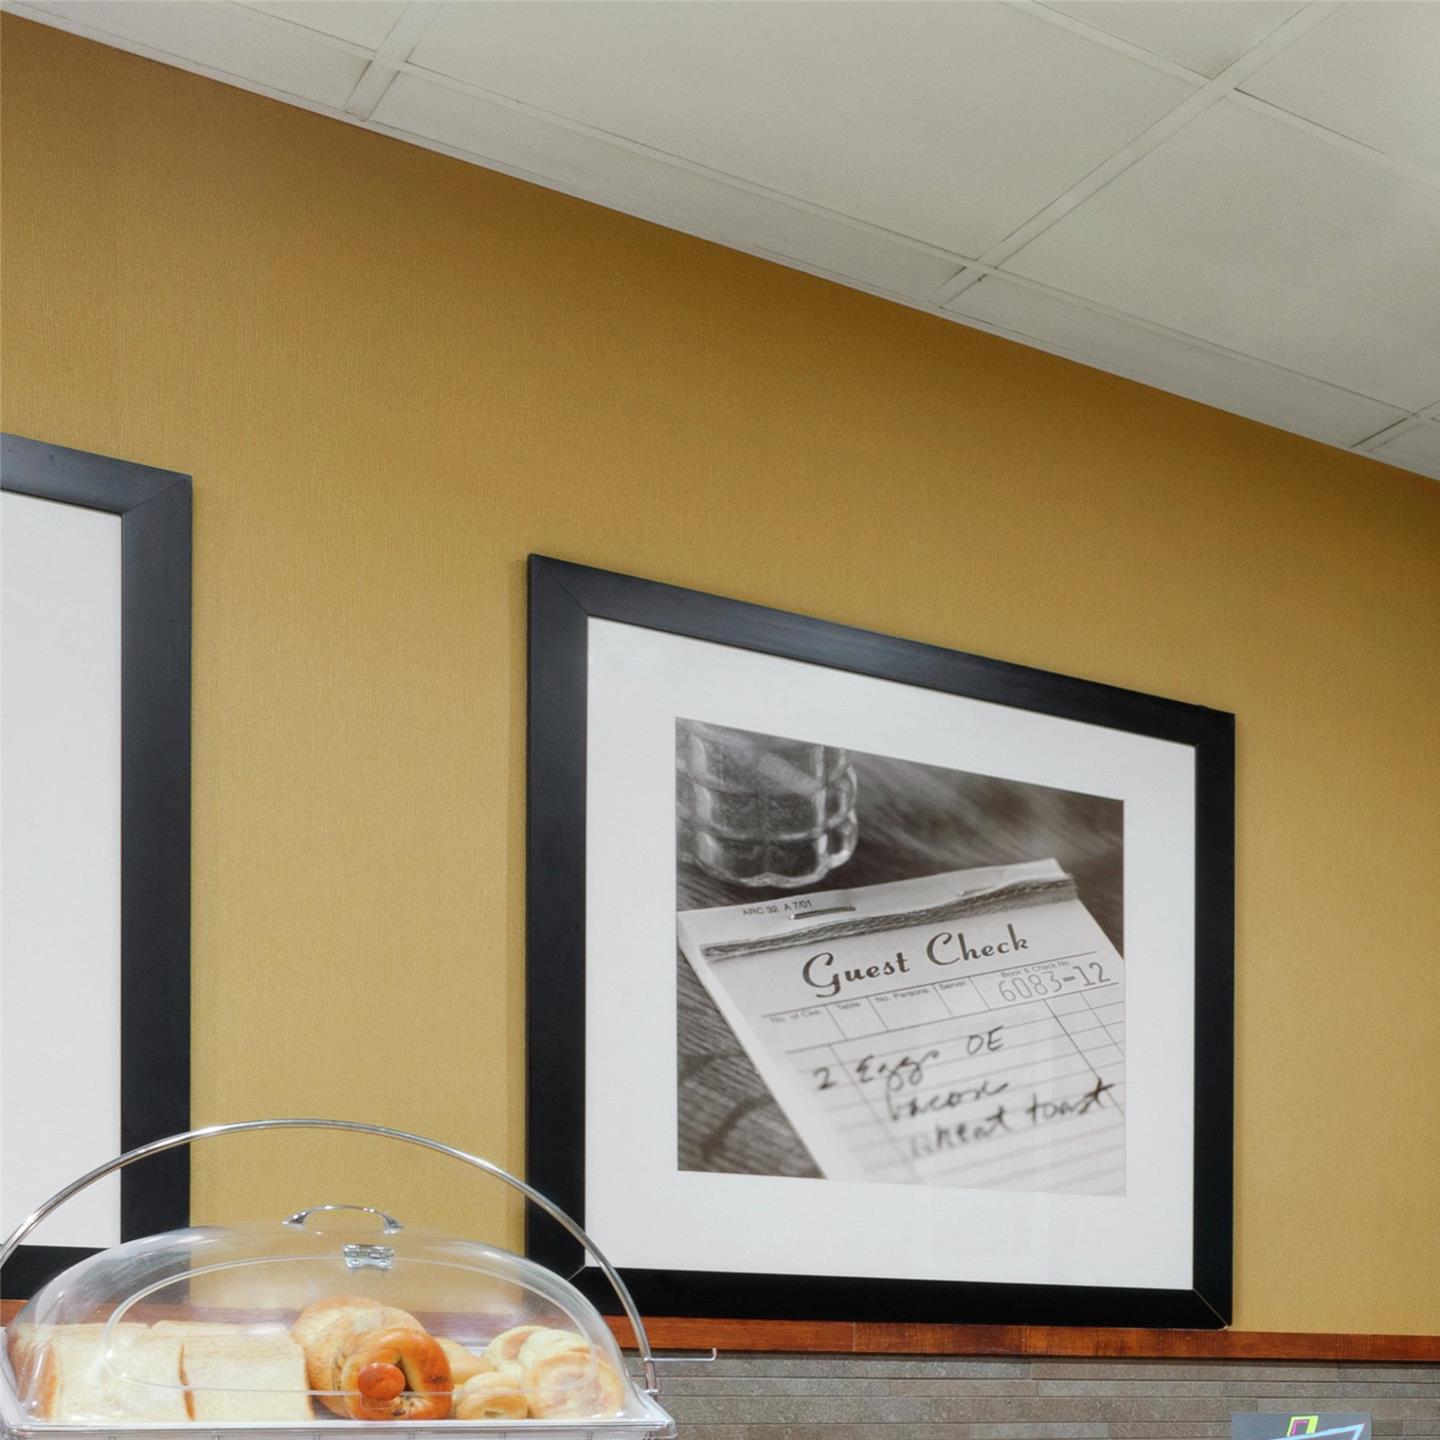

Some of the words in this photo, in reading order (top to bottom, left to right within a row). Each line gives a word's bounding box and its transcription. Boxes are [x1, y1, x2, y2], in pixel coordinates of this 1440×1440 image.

[802, 951, 911, 998] Guest
[926, 923, 1029, 967] Check
[998, 961, 1111, 1002] 6083-12
